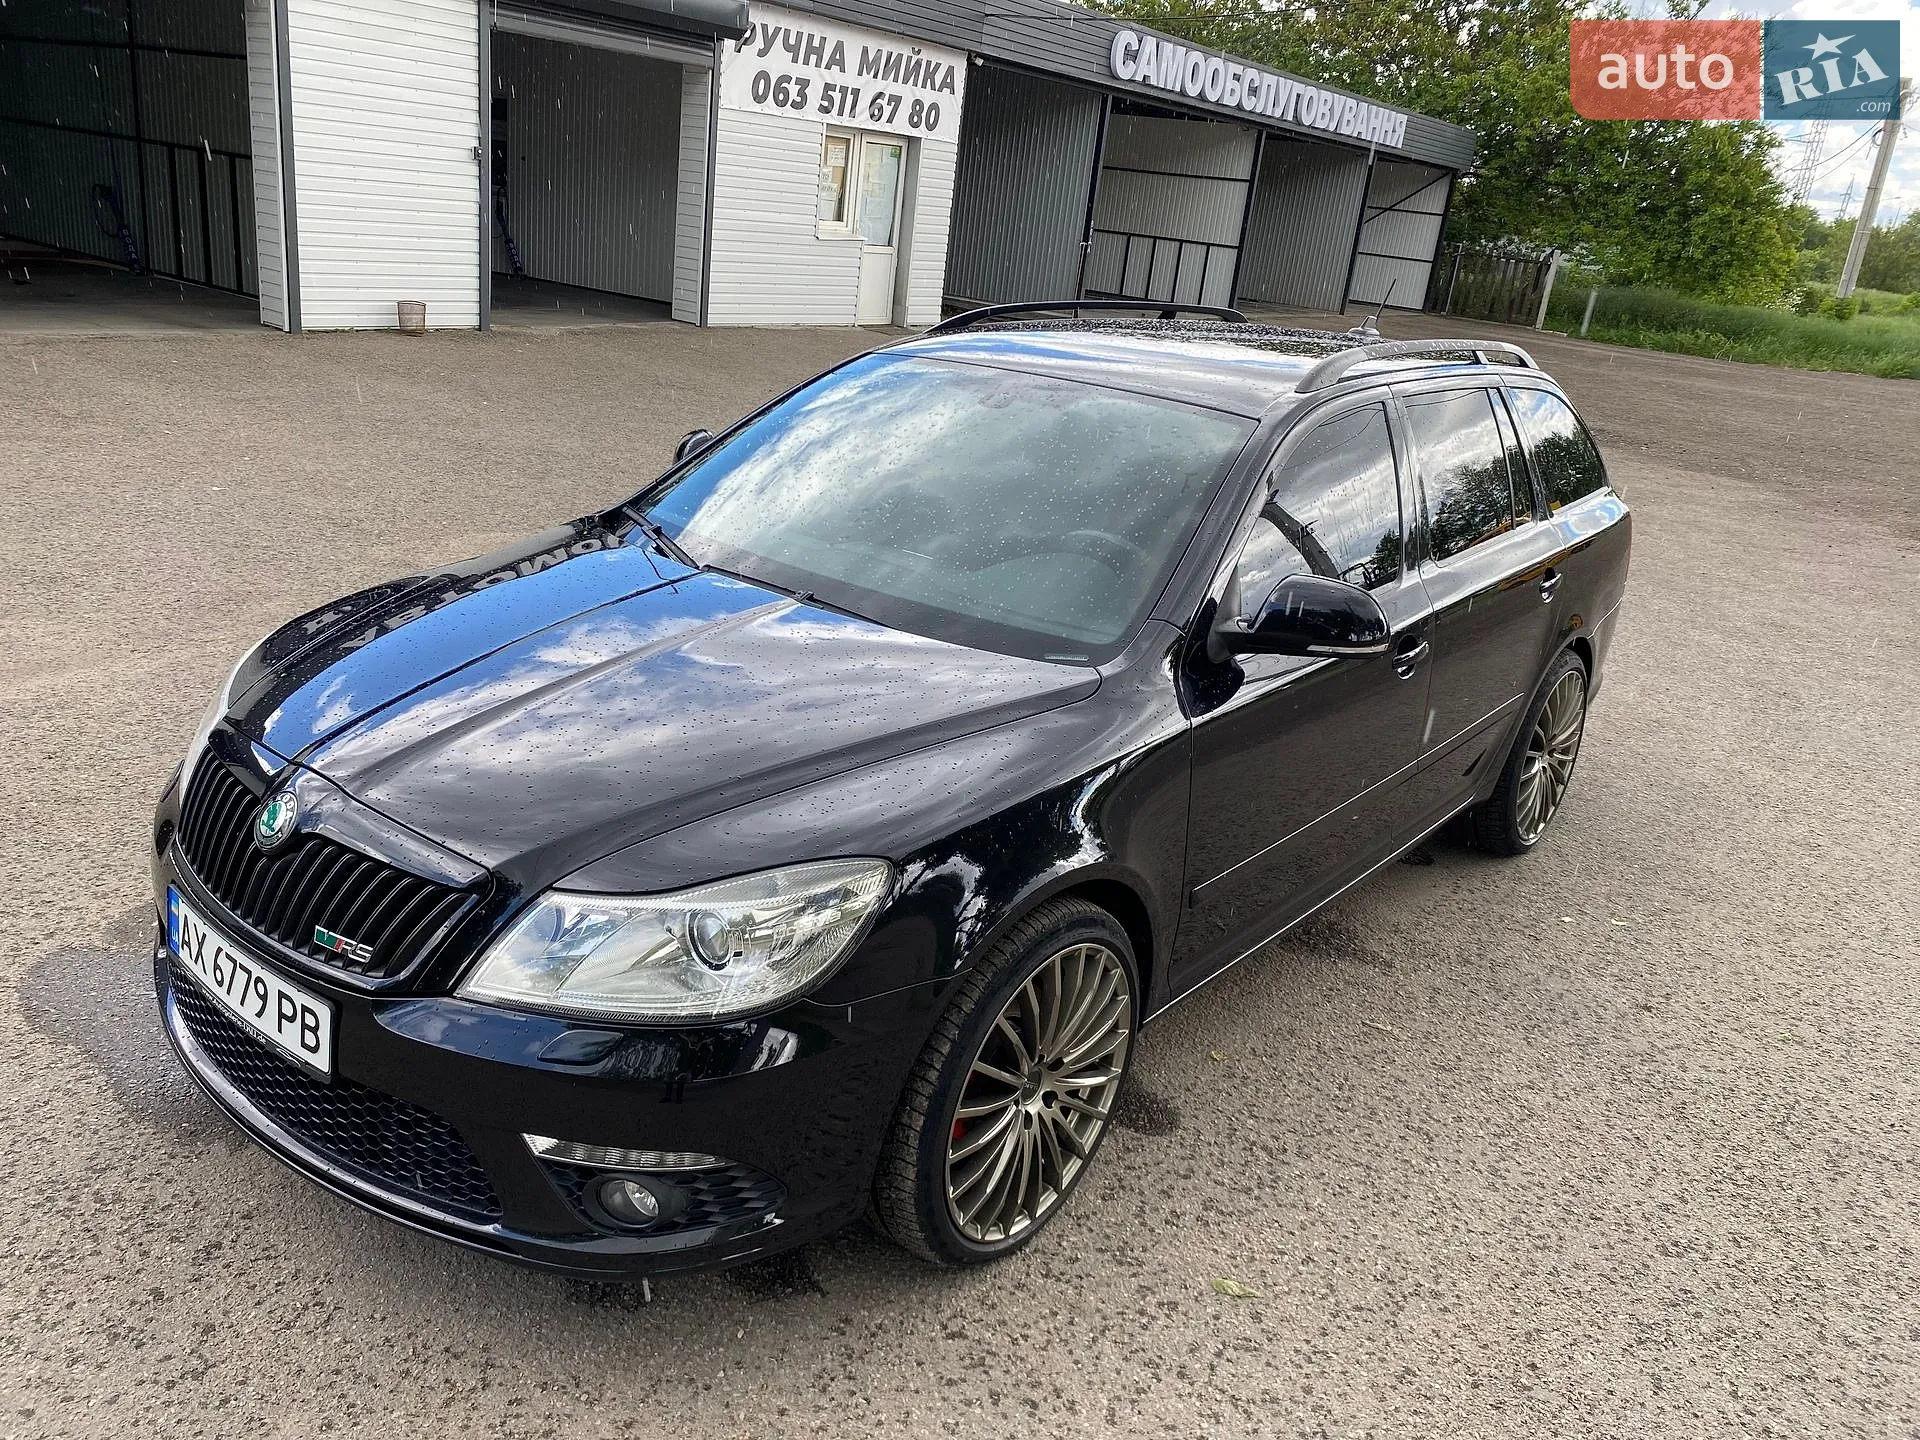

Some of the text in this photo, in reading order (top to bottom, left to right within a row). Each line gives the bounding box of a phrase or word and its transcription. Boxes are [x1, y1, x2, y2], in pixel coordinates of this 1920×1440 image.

[751, 70, 941, 132] 063 511 67 80
[857, 47, 956, 95] МИЙКА
[1111, 30, 1408, 149] САМООБСЛУГОВУВАННЯ
[171, 926, 179, 945] UA
[181, 914, 320, 1054] AX 6779 PB
